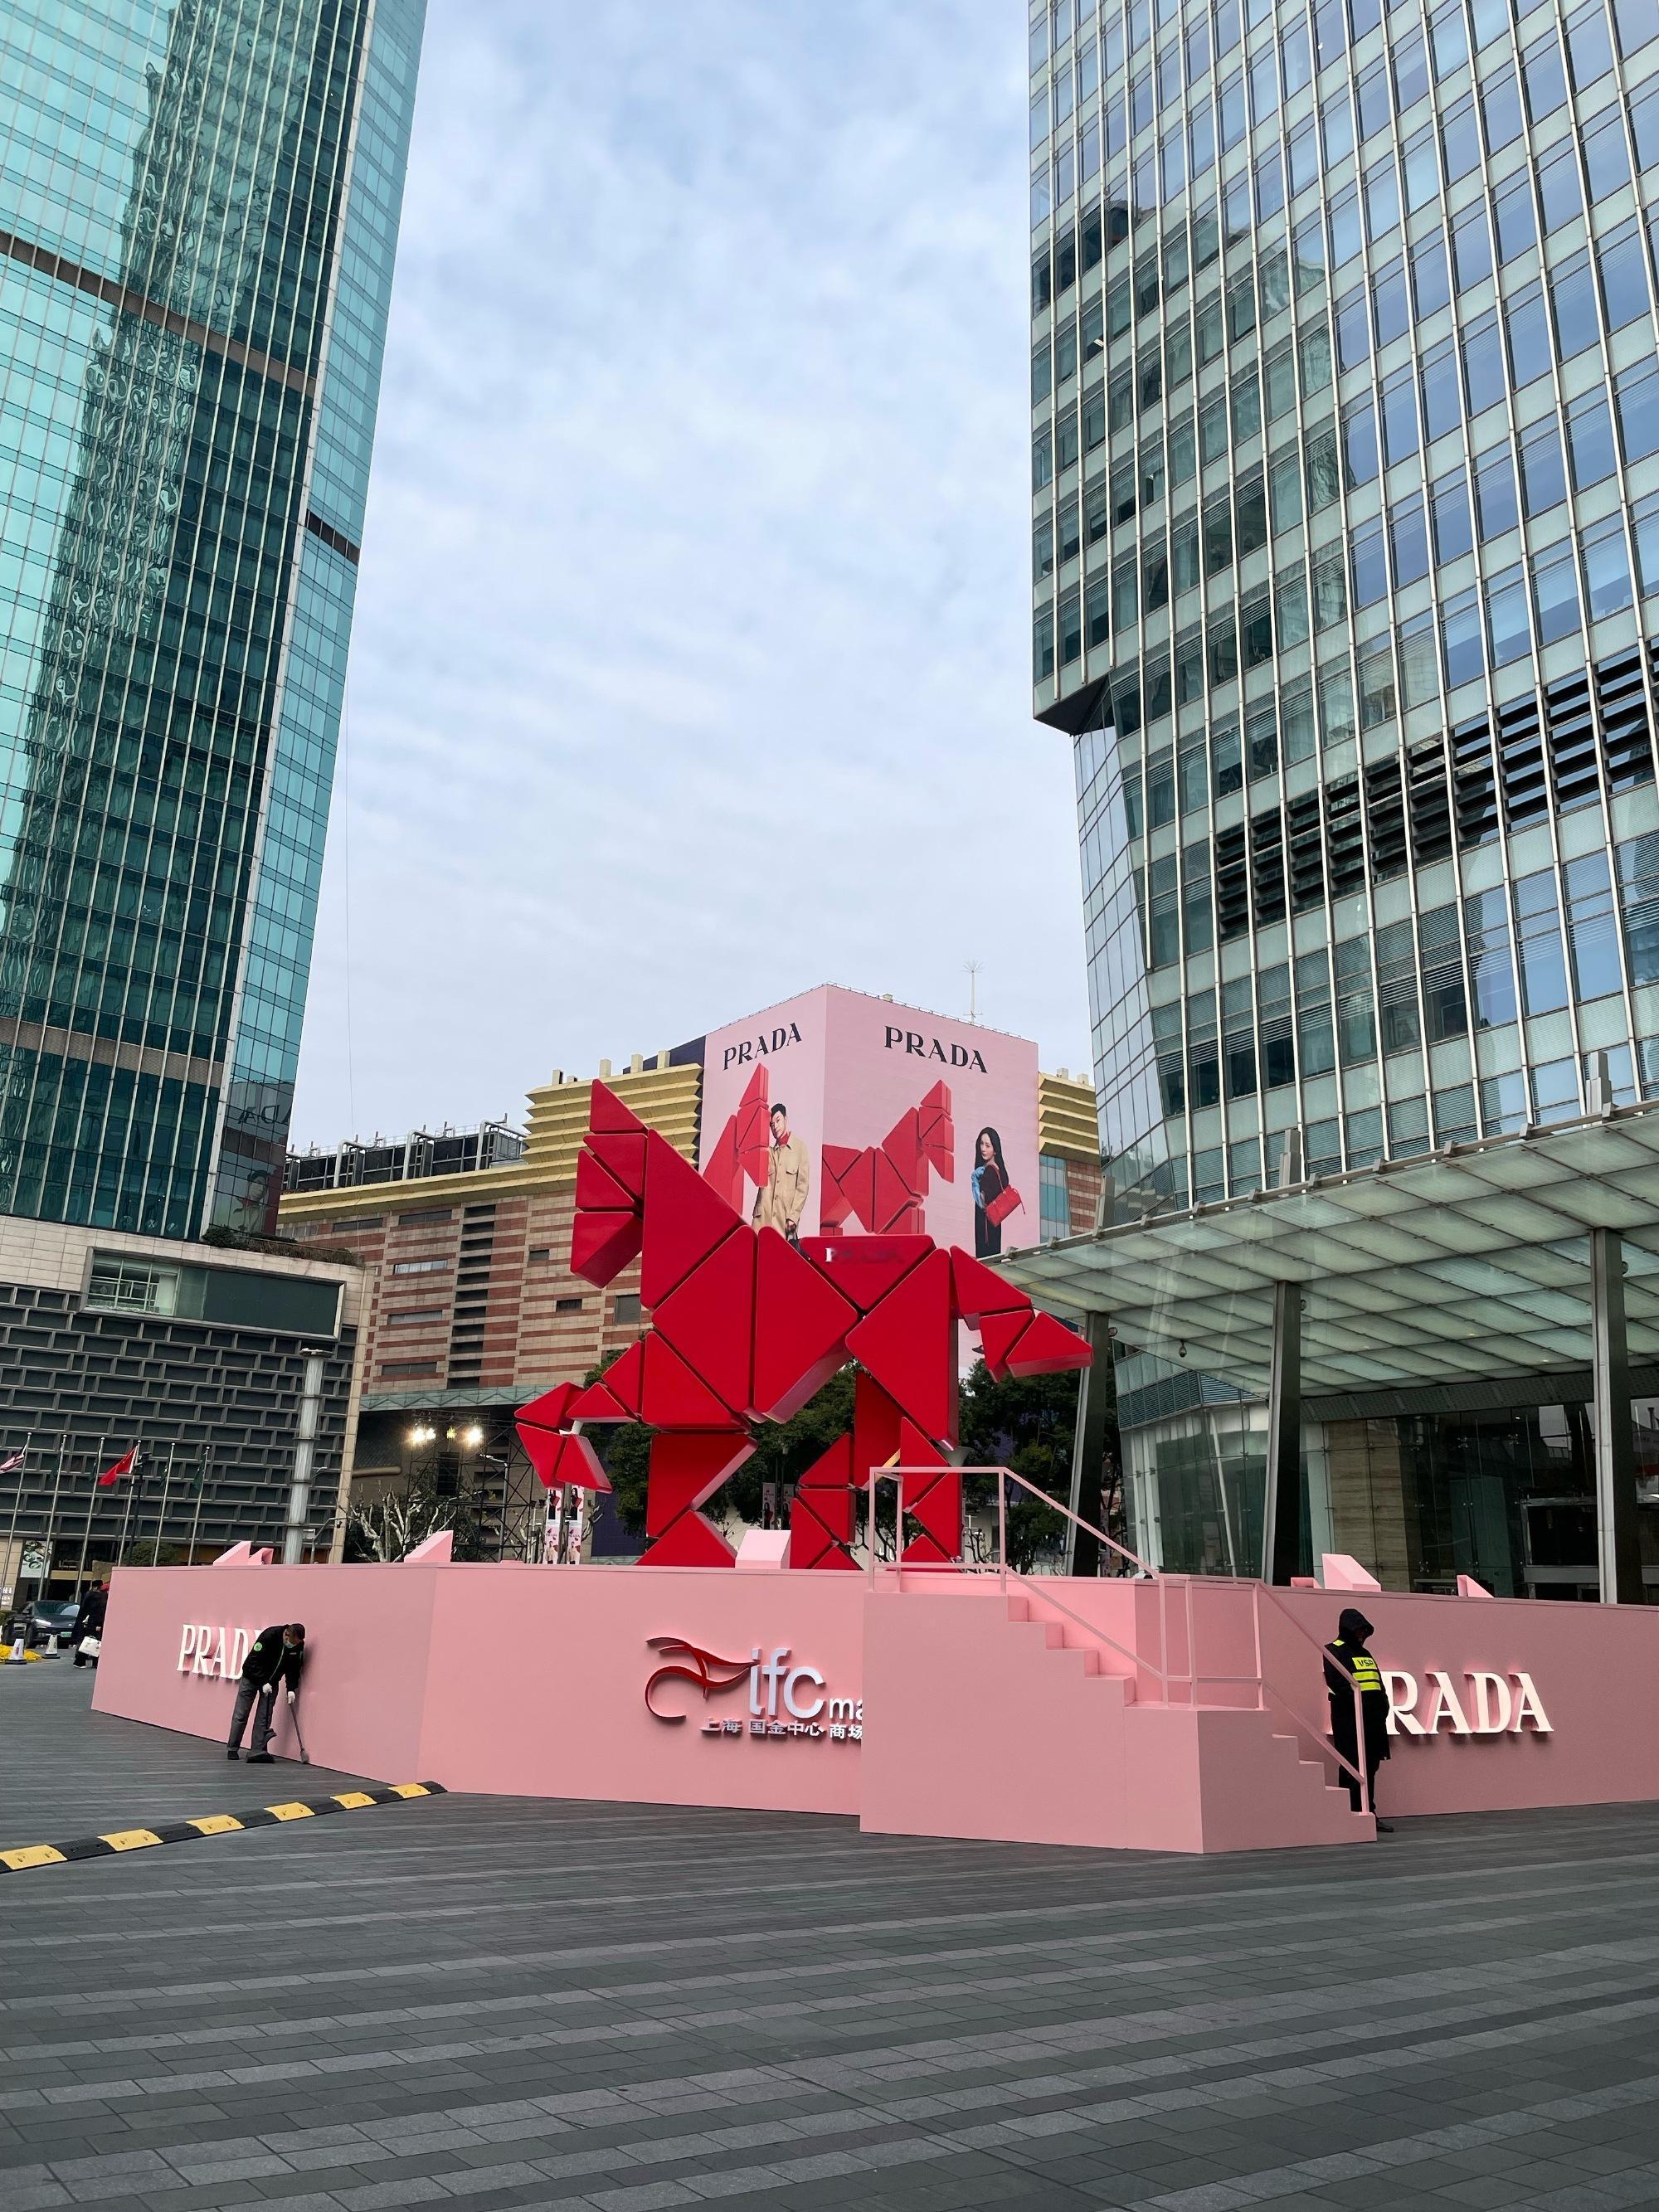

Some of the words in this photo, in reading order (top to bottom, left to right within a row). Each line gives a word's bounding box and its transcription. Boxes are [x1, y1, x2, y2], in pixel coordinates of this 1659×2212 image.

[723, 1022, 802, 1070] PRADA
[884, 1025, 988, 1073] PRADA
[177, 1624, 262, 1680] PRAD
[749, 1647, 826, 1719] ifc
[1327, 1670, 1554, 1735] RADA
